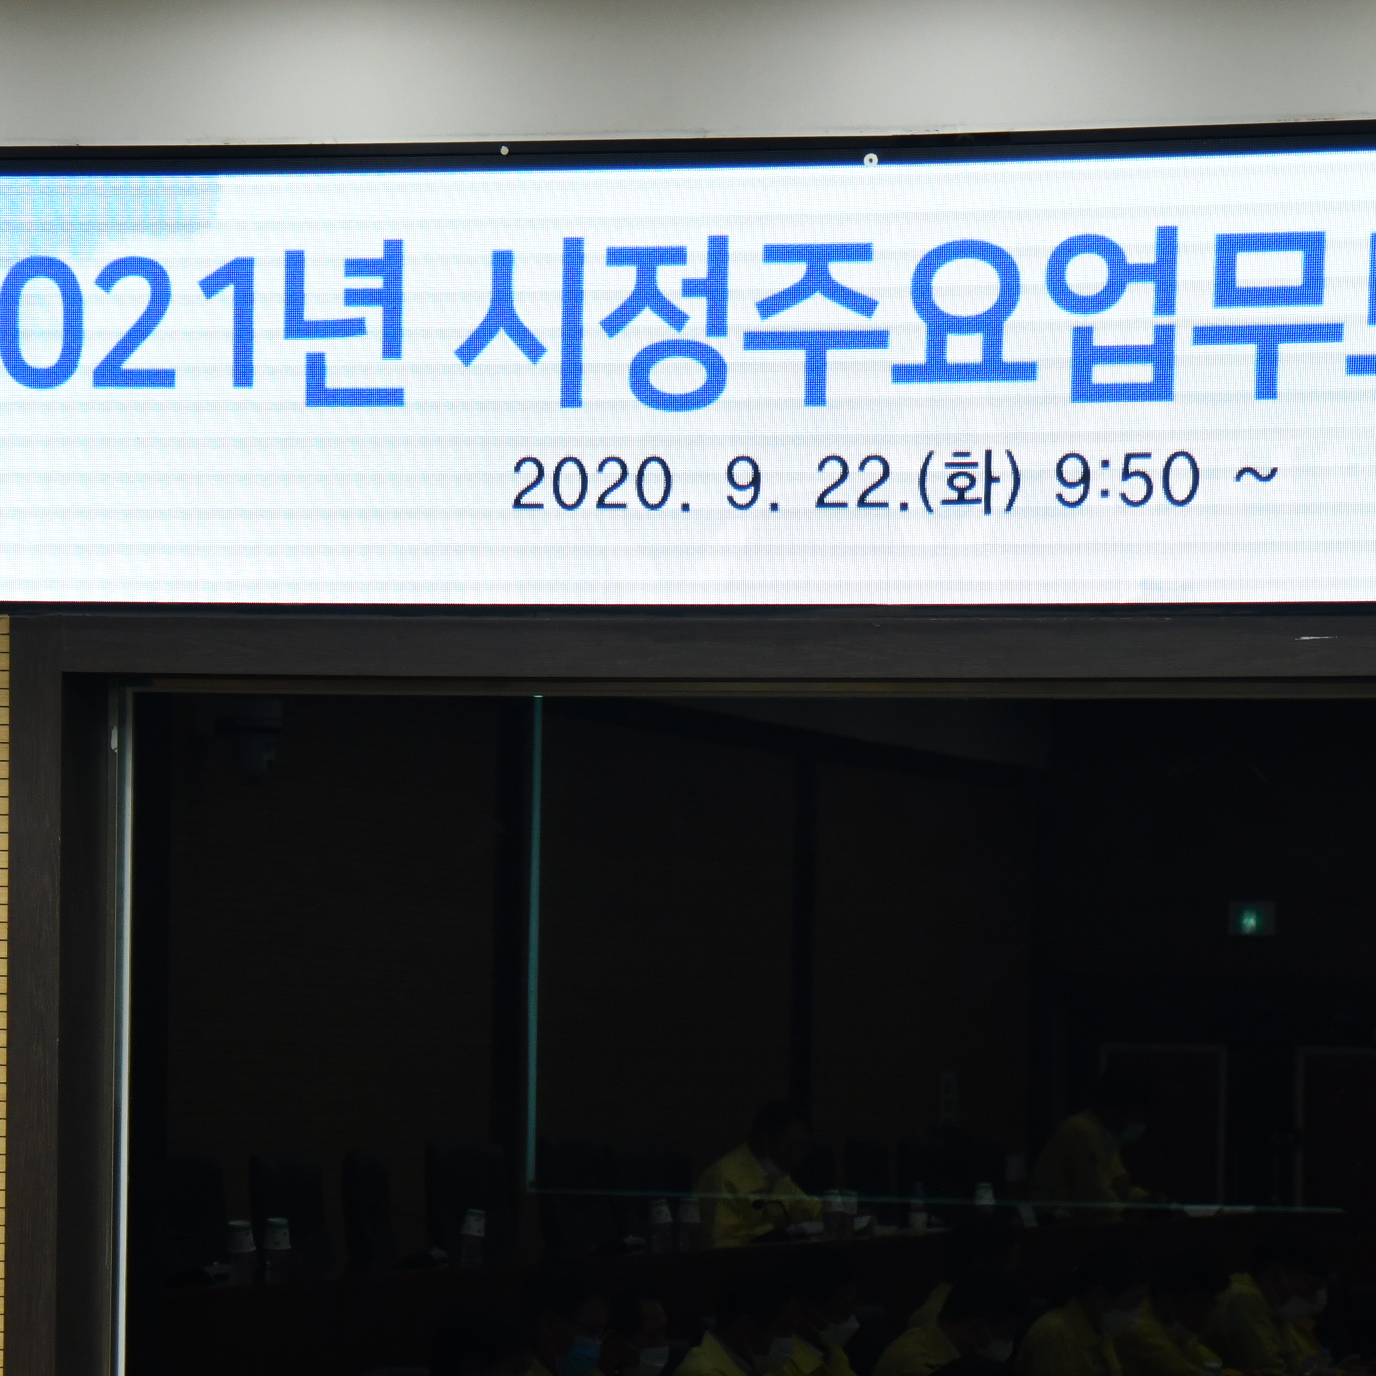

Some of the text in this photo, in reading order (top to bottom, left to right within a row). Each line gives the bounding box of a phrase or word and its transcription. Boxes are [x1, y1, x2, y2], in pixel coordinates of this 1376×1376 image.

[512, 456, 690, 513] 2020.
[726, 455, 779, 512] 9.
[1055, 451, 1200, 509] 9:50
